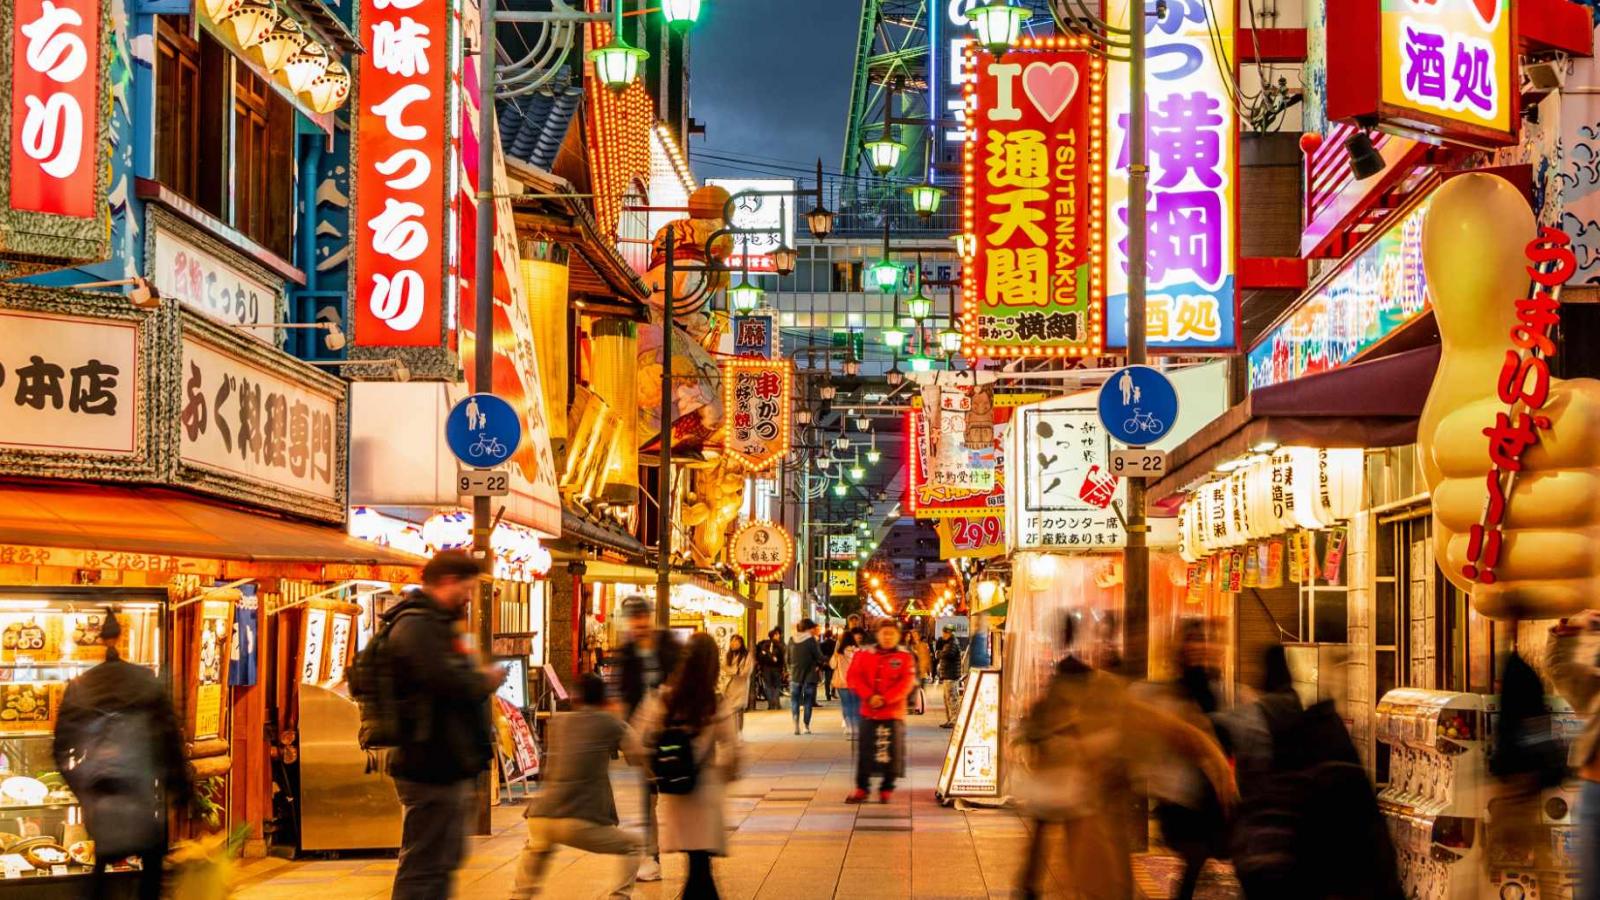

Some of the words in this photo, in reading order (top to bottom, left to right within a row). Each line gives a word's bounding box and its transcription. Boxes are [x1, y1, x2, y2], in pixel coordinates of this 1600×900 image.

[1406, 26, 1492, 111] 酒処
[21, 0, 88, 178] ちり
[367, 0, 432, 331] 味てっちり
[985, 129, 1050, 306] 通天閣
[1055, 128, 1077, 304] TSUTENKAKU
[978, 315, 1015, 325] 日本一の
[978, 328, 1014, 340] 串かつ
[1015, 311, 1077, 341] 横綱
[181, 359, 332, 485] ふぐ料理専門
[755, 372, 779, 439] 串かつ
[1114, 456, 1162, 471] 9-22
[460, 477, 506, 491] 9-22
[953, 516, 1000, 549] 299
[1026, 533, 1039, 545] 2F
[1042, 532, 1119, 545] 座敷あります
[1027, 517, 1039, 529] 1F
[1042, 517, 1119, 529] カウンター席
